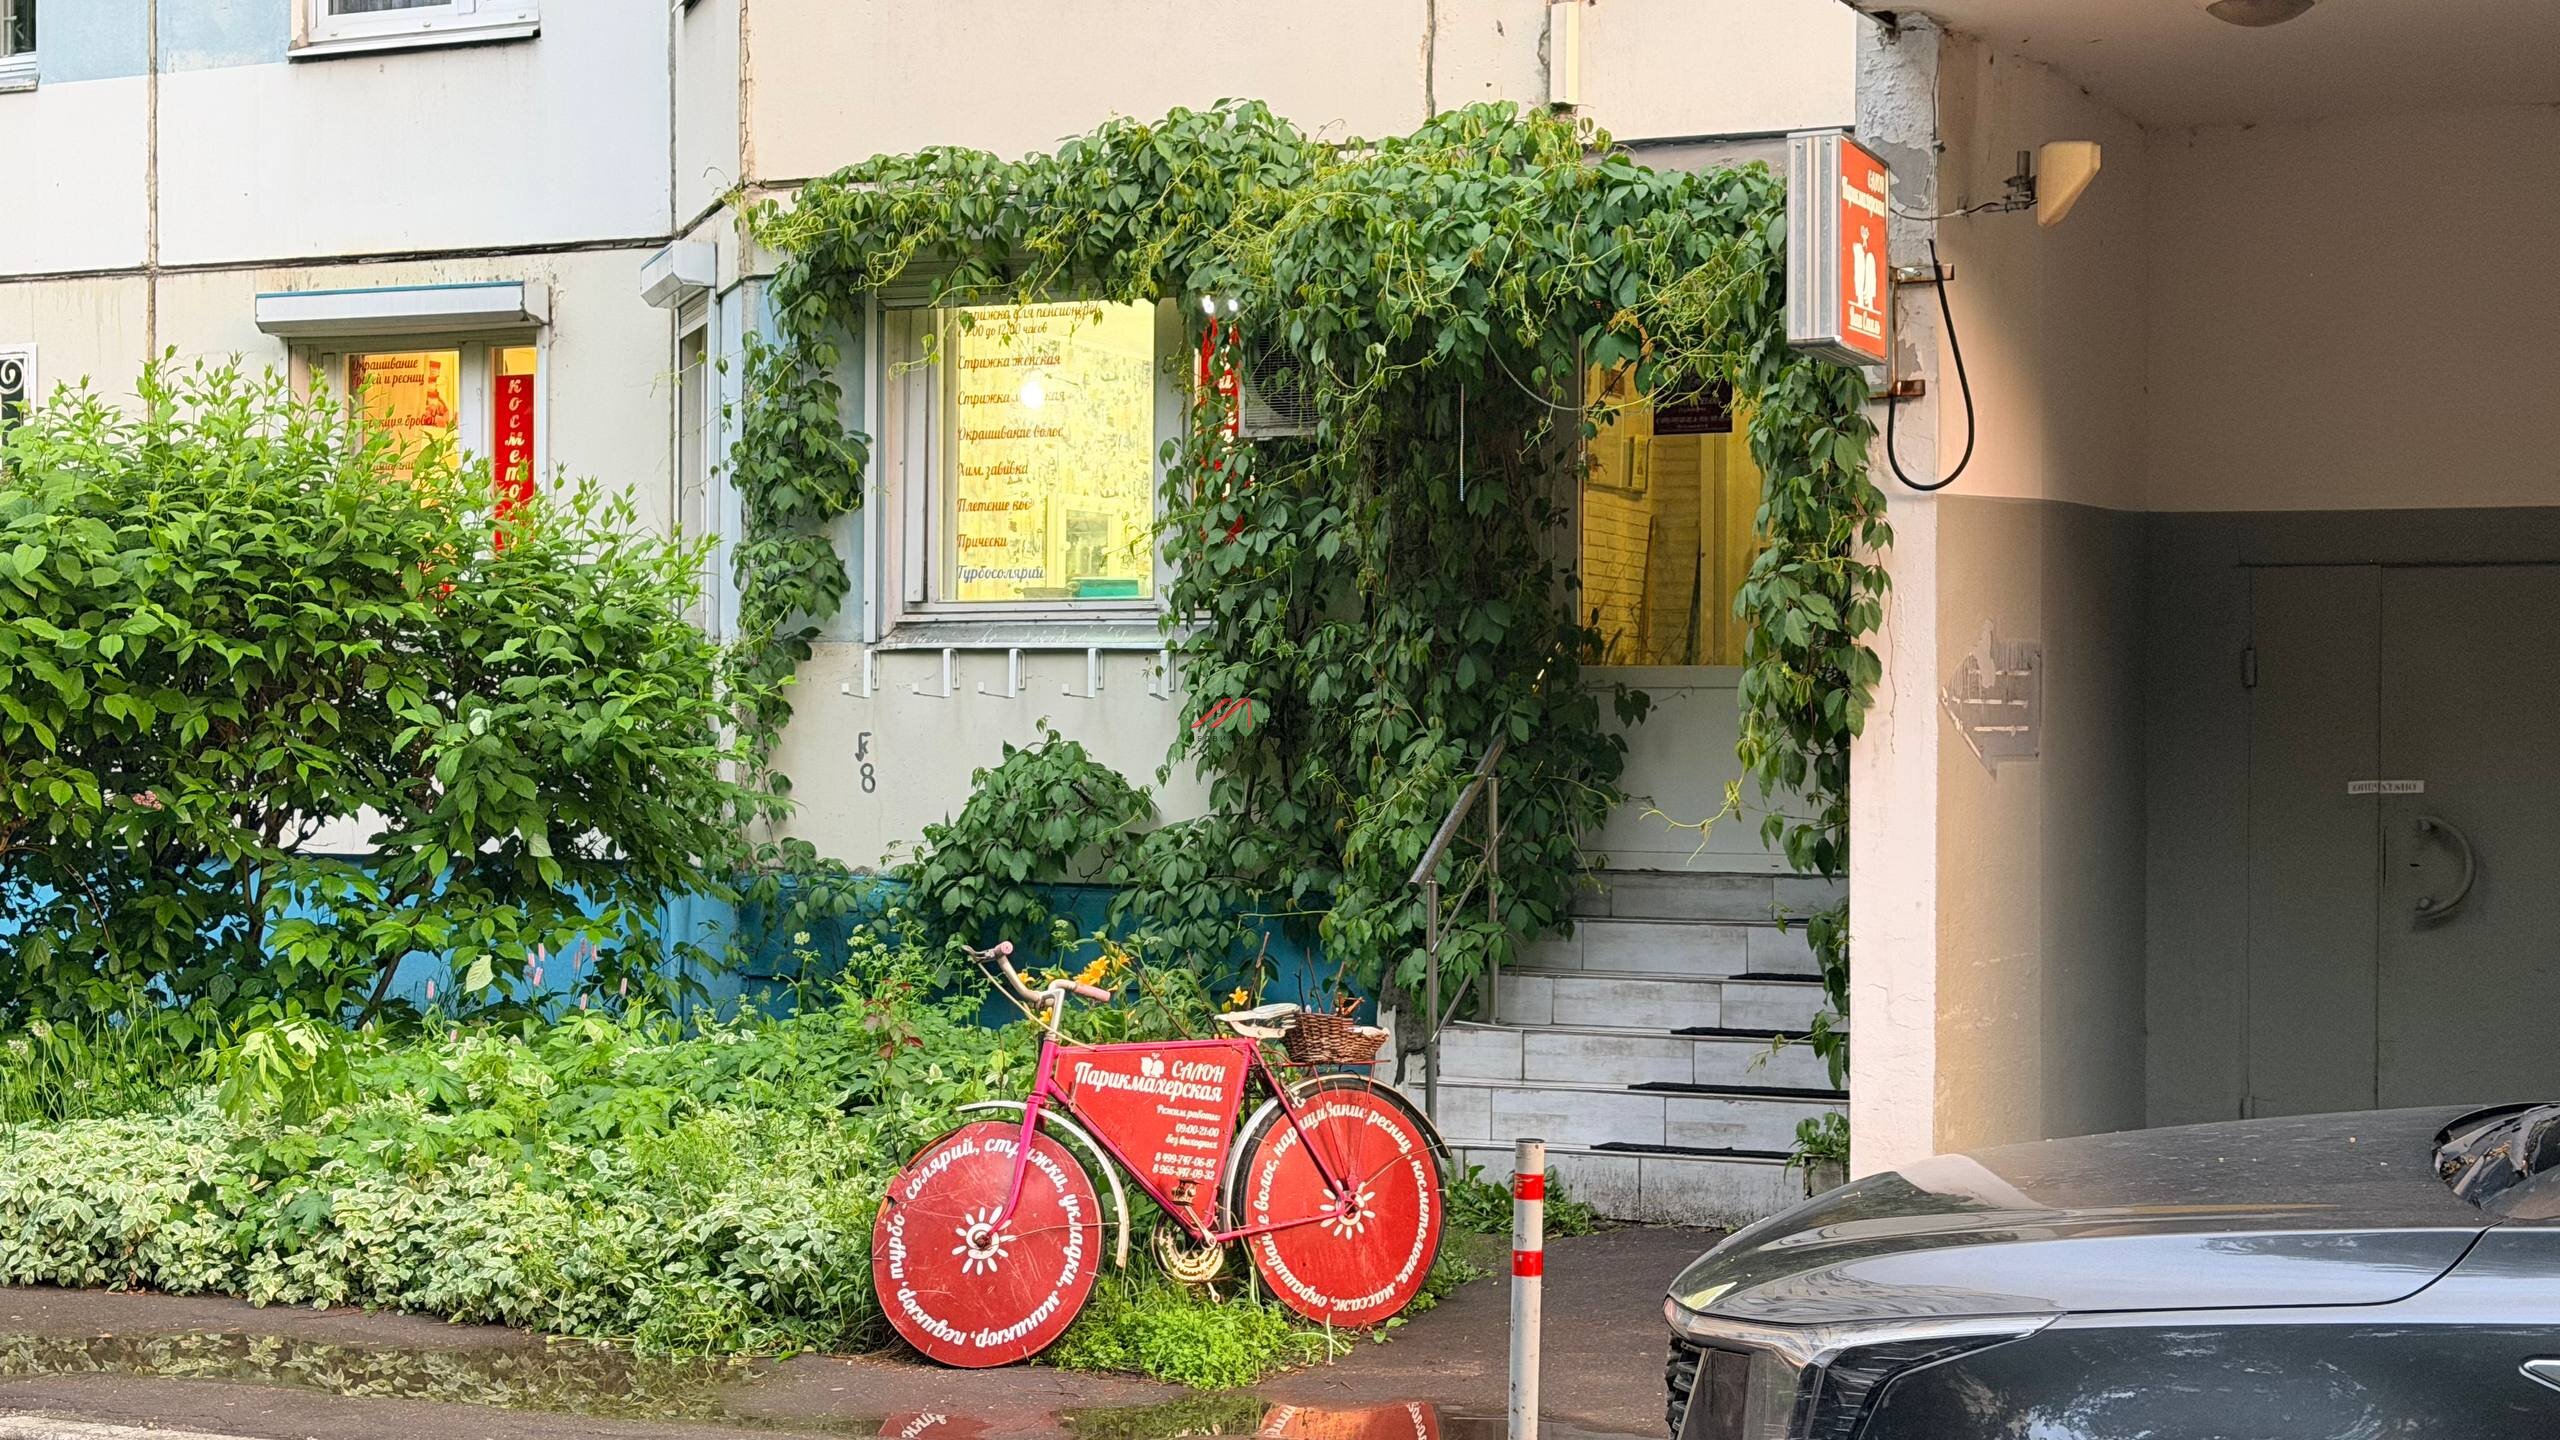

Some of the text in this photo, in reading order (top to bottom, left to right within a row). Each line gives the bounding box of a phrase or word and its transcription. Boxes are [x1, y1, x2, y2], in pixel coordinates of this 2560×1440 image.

[985, 327, 996, 339] до
[957, 355, 1061, 372] Стрижка женская
[383, 375, 390, 384] и
[391, 373, 425, 387] ресниц
[957, 390, 1010, 408] Стрижка
[957, 425, 1064, 444] Окрашивание волос
[985, 460, 1029, 480] завивка
[956, 498, 1031, 512] Плетение кос
[956, 534, 1008, 552] Прически
[956, 565, 1045, 583] Турбосолярий
[1171, 1060, 1226, 1083] САЛОН
[1074, 1061, 1224, 1102] Парикмахерская
[1156, 1104, 1187, 1117] Режим
[1366, 1109, 1413, 1160] ресниц,
[1154, 1151, 1162, 1162] 8
[1152, 1163, 1160, 1174] 8
[1253, 1158, 1281, 1212] волос,
[1056, 1193, 1084, 1286] укладки,
[1330, 1281, 1397, 1312] массаж,
[897, 1281, 968, 1346] педикюр,
[970, 1289, 1061, 1348] маникюр,
